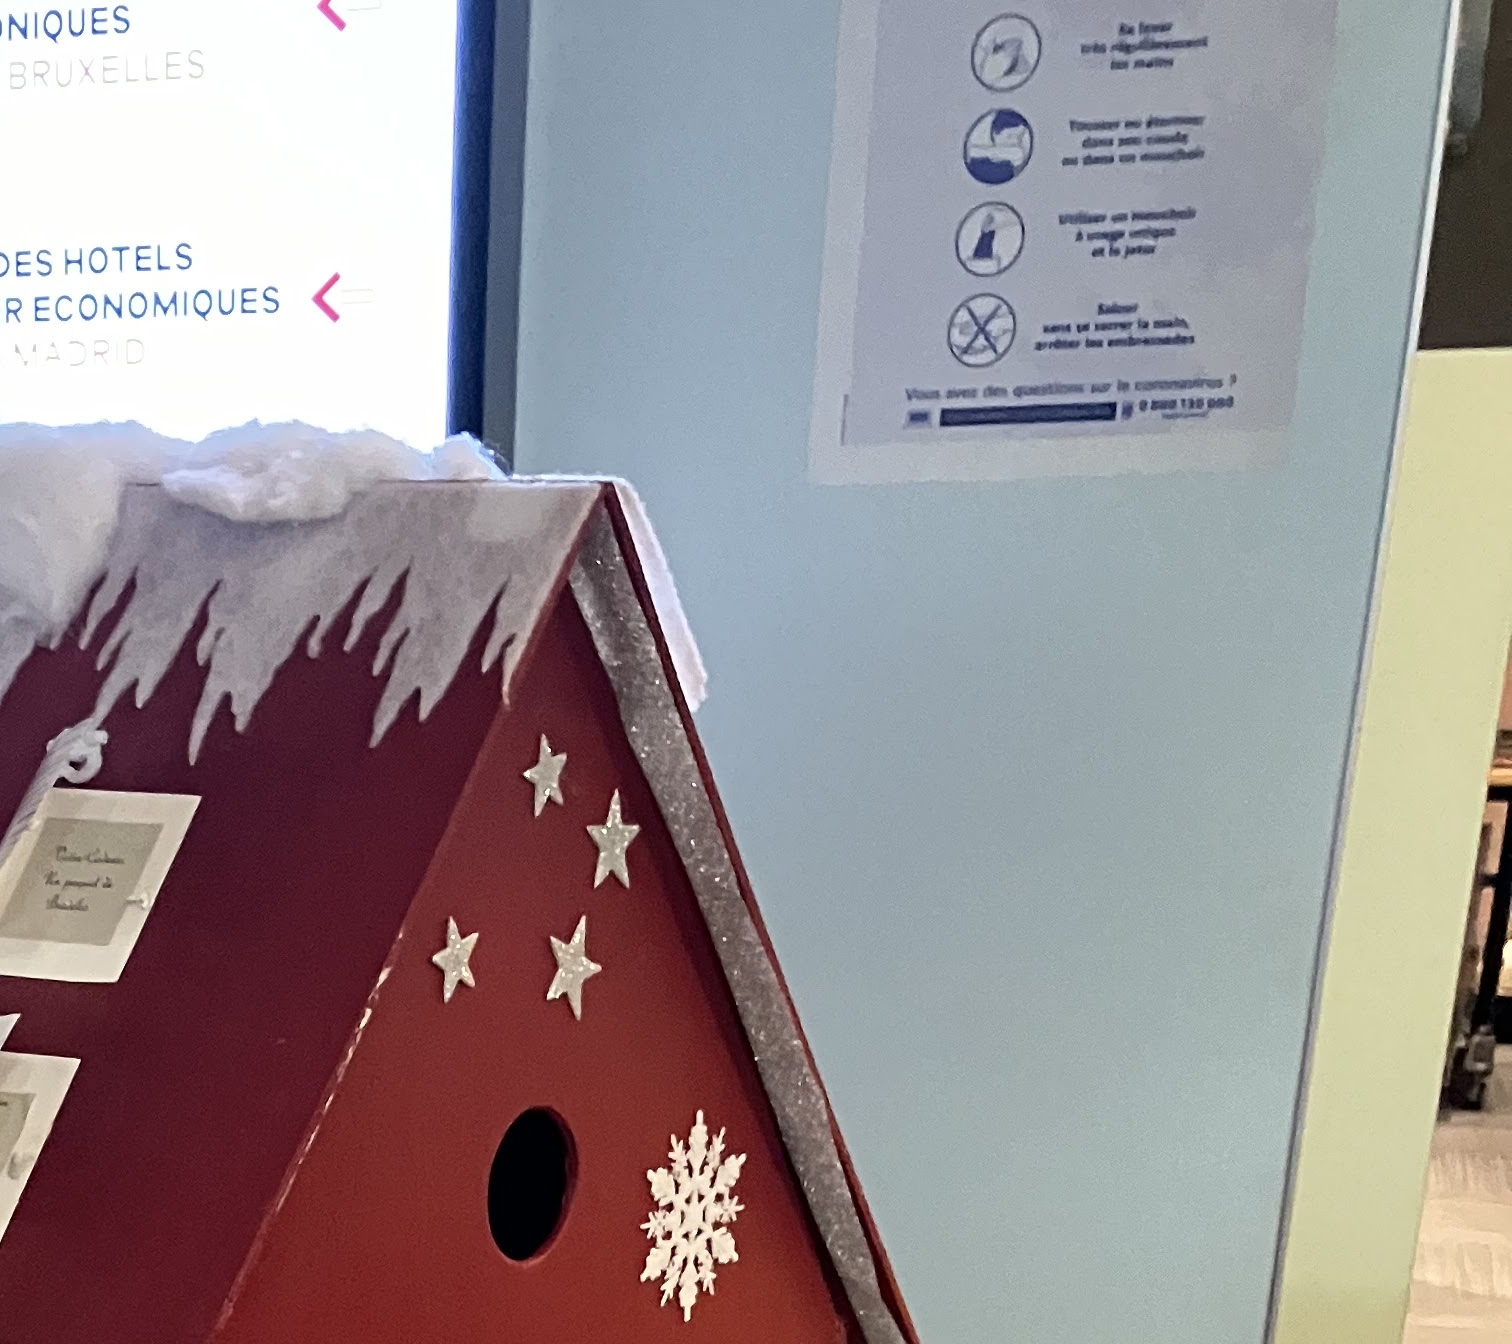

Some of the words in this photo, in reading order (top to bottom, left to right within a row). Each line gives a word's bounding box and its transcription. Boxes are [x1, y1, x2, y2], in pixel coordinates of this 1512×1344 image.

[8, 50, 206, 92] BRUXELLES
[64, 243, 193, 275] HOTELS
[34, 286, 281, 323] ECONOMIQUES
[12, 337, 145, 368] MADRID
